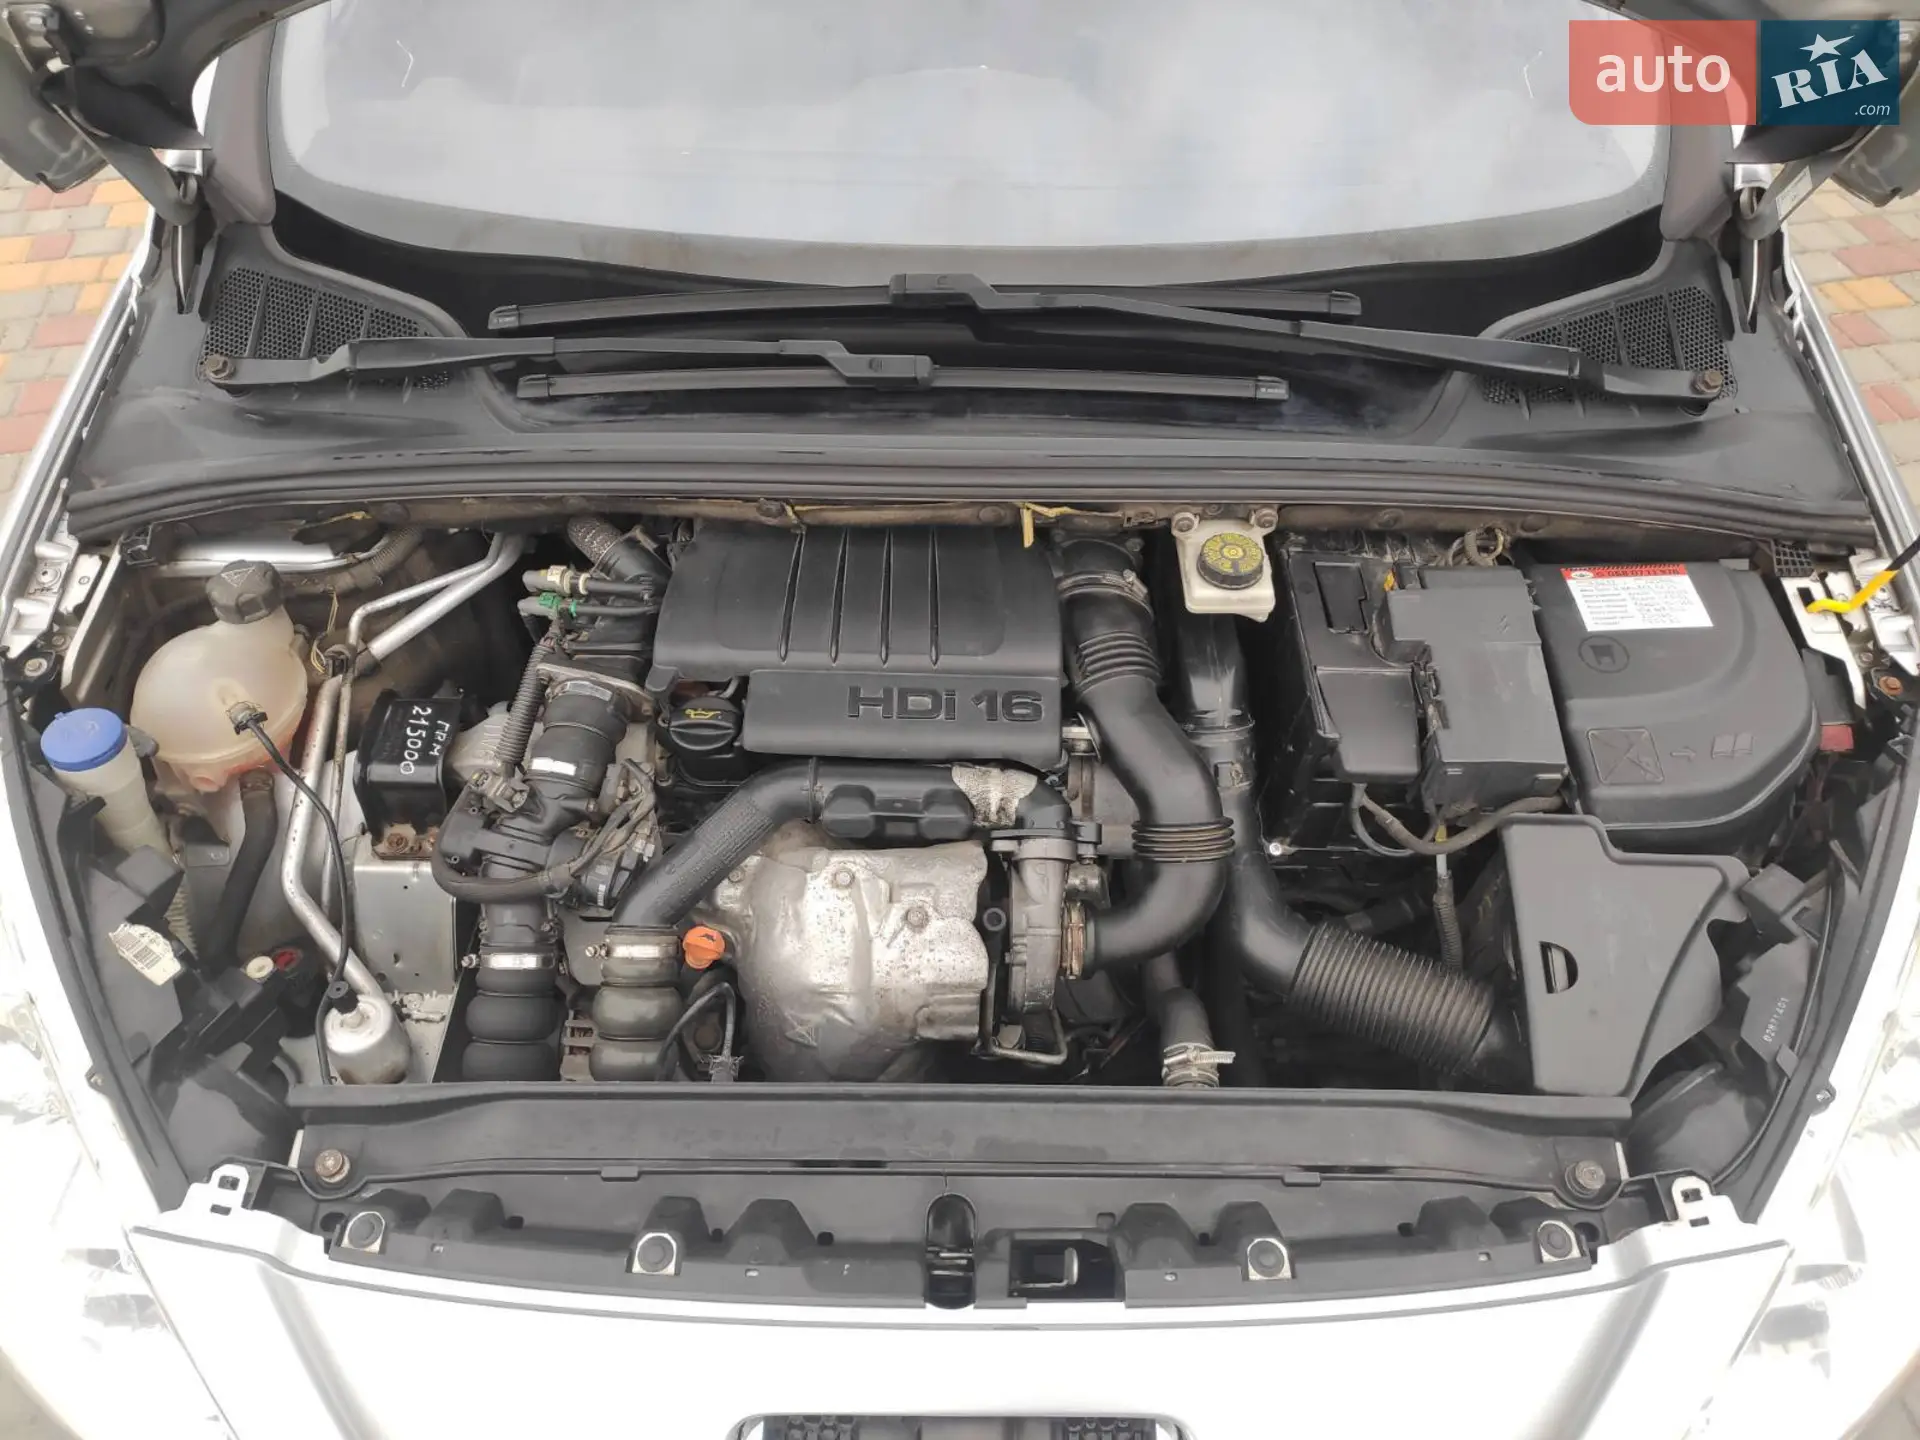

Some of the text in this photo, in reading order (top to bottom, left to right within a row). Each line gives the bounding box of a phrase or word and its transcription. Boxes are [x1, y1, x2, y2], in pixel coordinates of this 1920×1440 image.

[848, 686, 1044, 722] HDi 16
[400, 705, 432, 775] 215000
